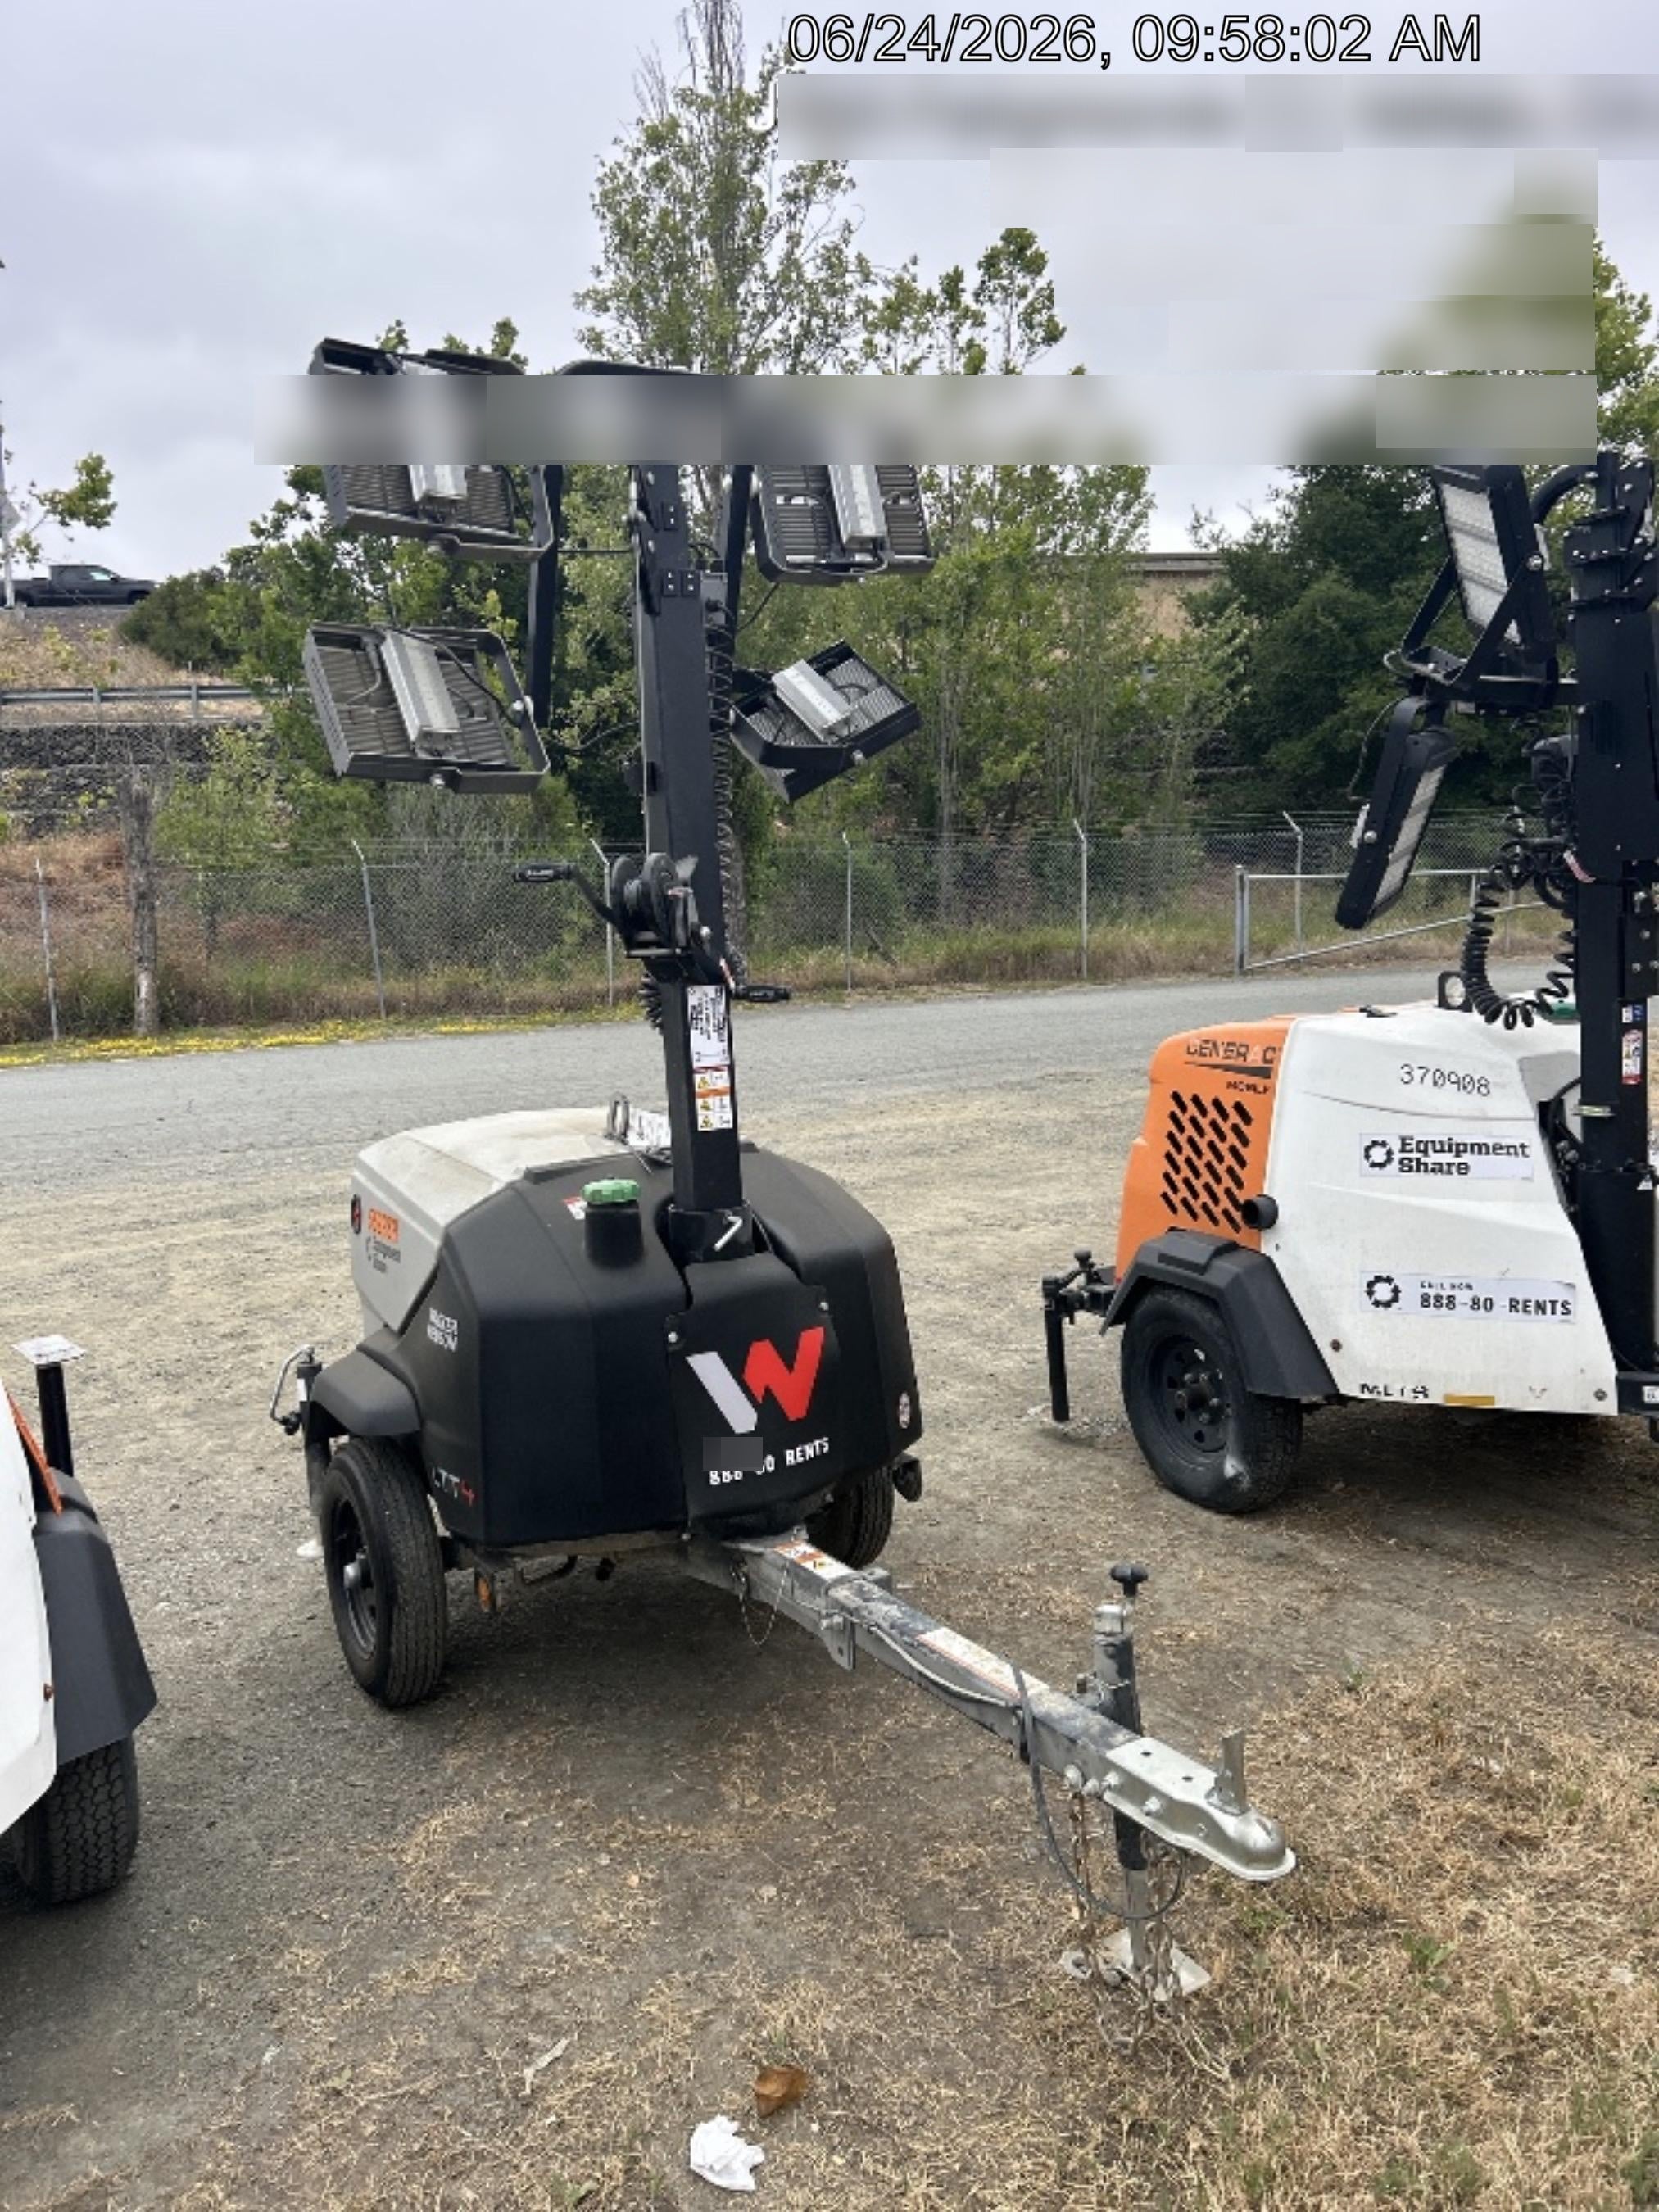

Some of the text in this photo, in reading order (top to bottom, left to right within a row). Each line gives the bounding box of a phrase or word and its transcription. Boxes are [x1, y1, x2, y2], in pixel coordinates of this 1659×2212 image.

[1400, 1063, 1491, 1097] 370908
[1398, 1135, 1530, 1158] Equipment
[1398, 1157, 1471, 1176] Share
[785, 1437, 830, 1466] RENTS
